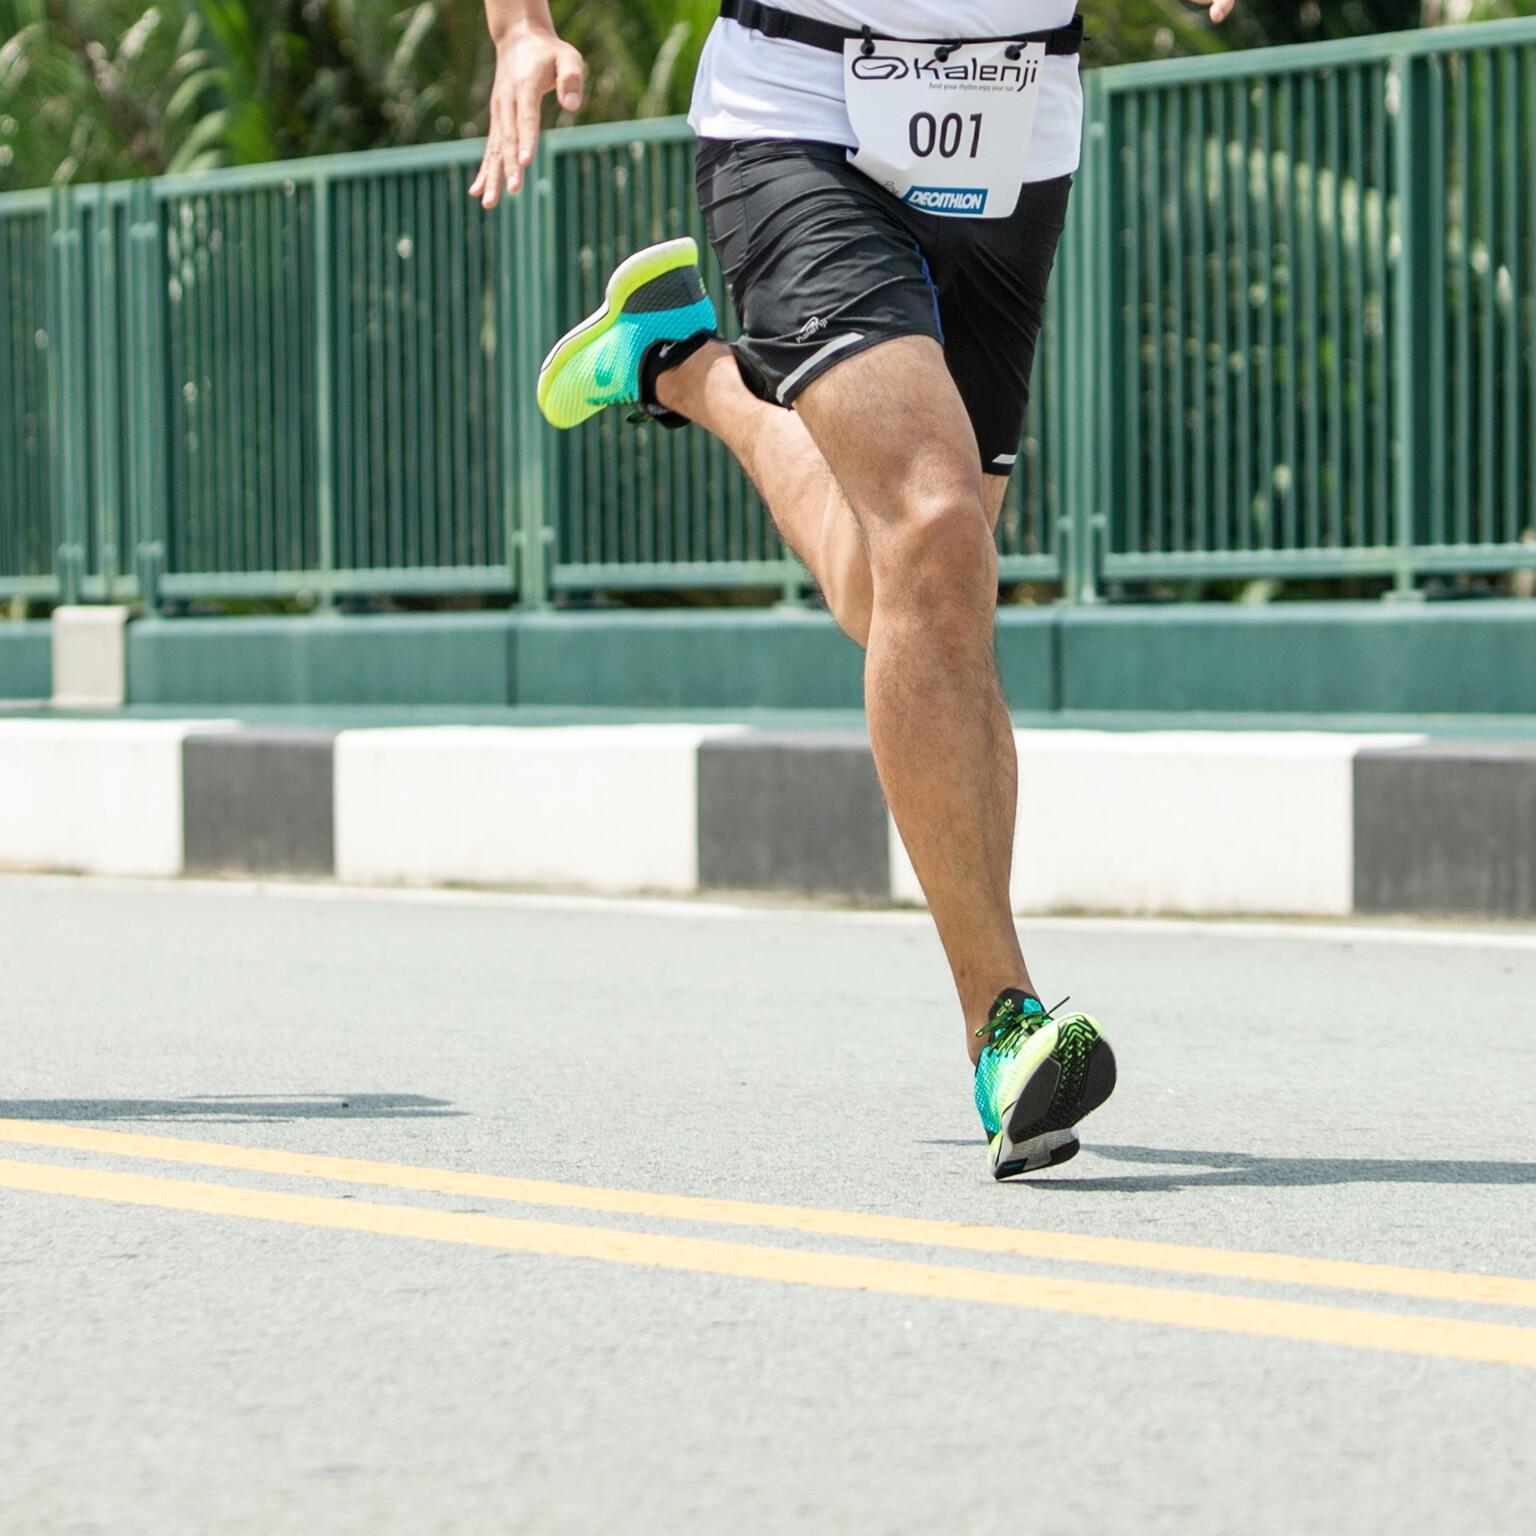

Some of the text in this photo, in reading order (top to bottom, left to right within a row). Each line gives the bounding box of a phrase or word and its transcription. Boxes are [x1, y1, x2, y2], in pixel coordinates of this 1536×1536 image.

[914, 58, 1039, 92] Kalenji
[908, 111, 983, 159] 001
[907, 190, 983, 210] DECATHLON
